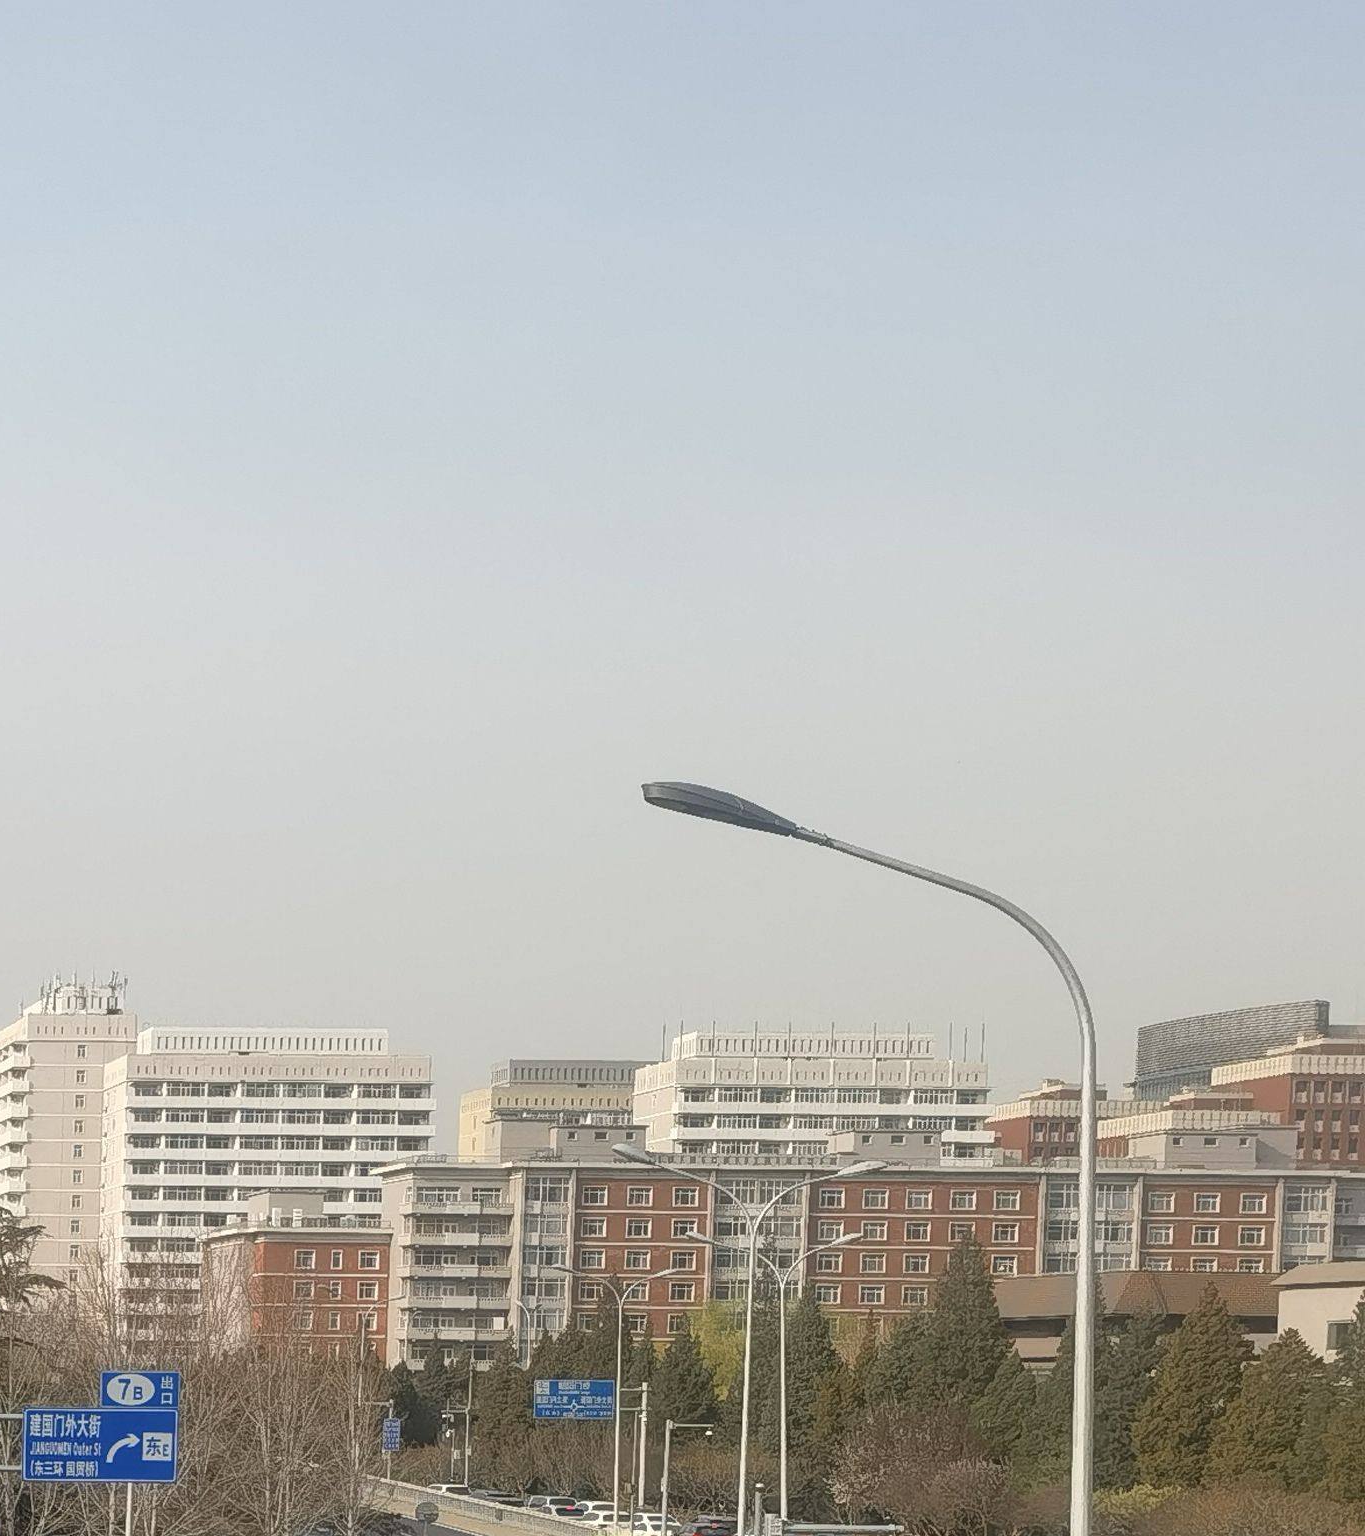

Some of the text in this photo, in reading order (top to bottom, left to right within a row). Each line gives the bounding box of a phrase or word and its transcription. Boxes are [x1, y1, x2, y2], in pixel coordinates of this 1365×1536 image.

[117, 1378, 144, 1400] 7B
[161, 1375, 174, 1405] 出口
[29, 1413, 102, 1438] 建国门外大街
